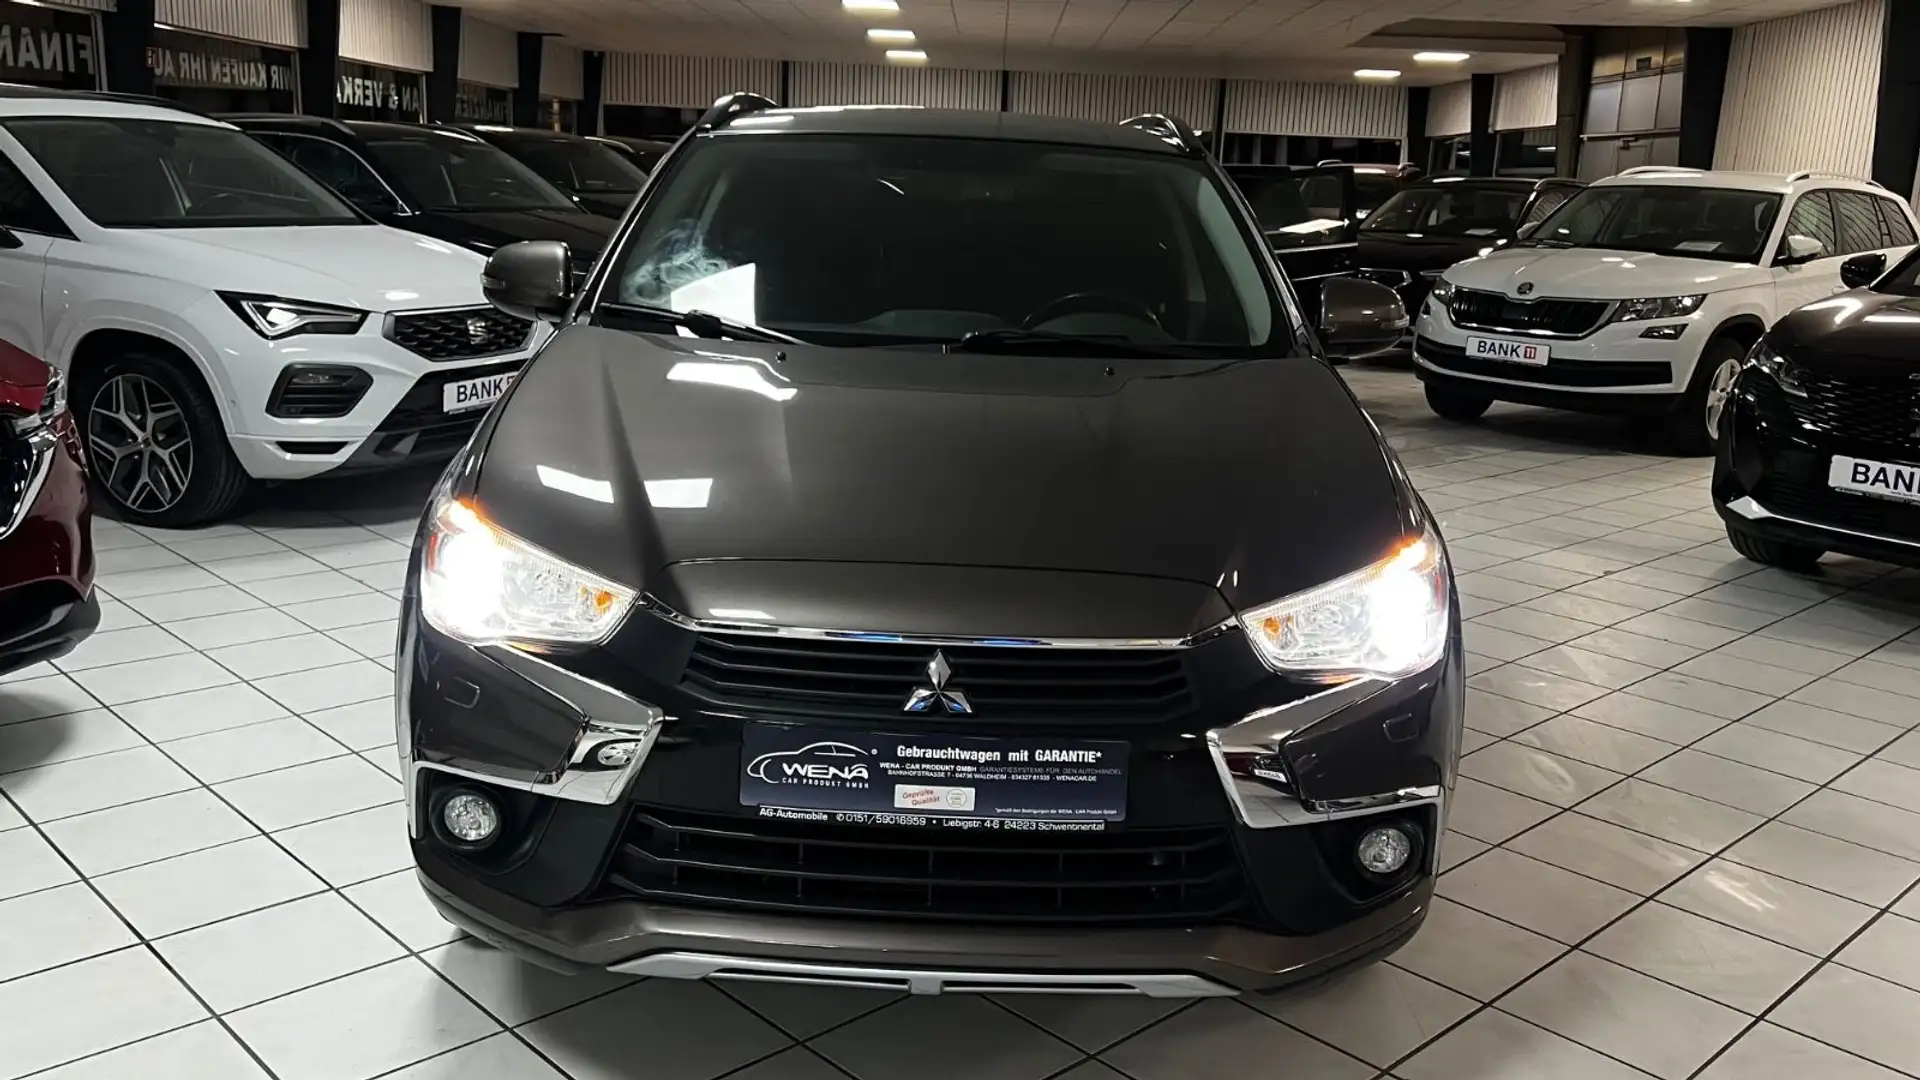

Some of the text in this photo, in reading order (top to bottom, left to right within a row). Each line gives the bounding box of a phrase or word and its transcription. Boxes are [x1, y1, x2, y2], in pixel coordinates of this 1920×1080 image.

[1477, 340, 1520, 358] BANK
[456, 377, 503, 403] BANK
[1851, 462, 1920, 494] BAN
[897, 745, 1001, 763] Gebrauchtwagen
[1008, 749, 1029, 762] mit
[782, 762, 869, 780] WENA
[921, 763, 955, 771] PRODUKT
[759, 806, 828, 821] AG-Automobile
[1004, 820, 1036, 831] 24223
